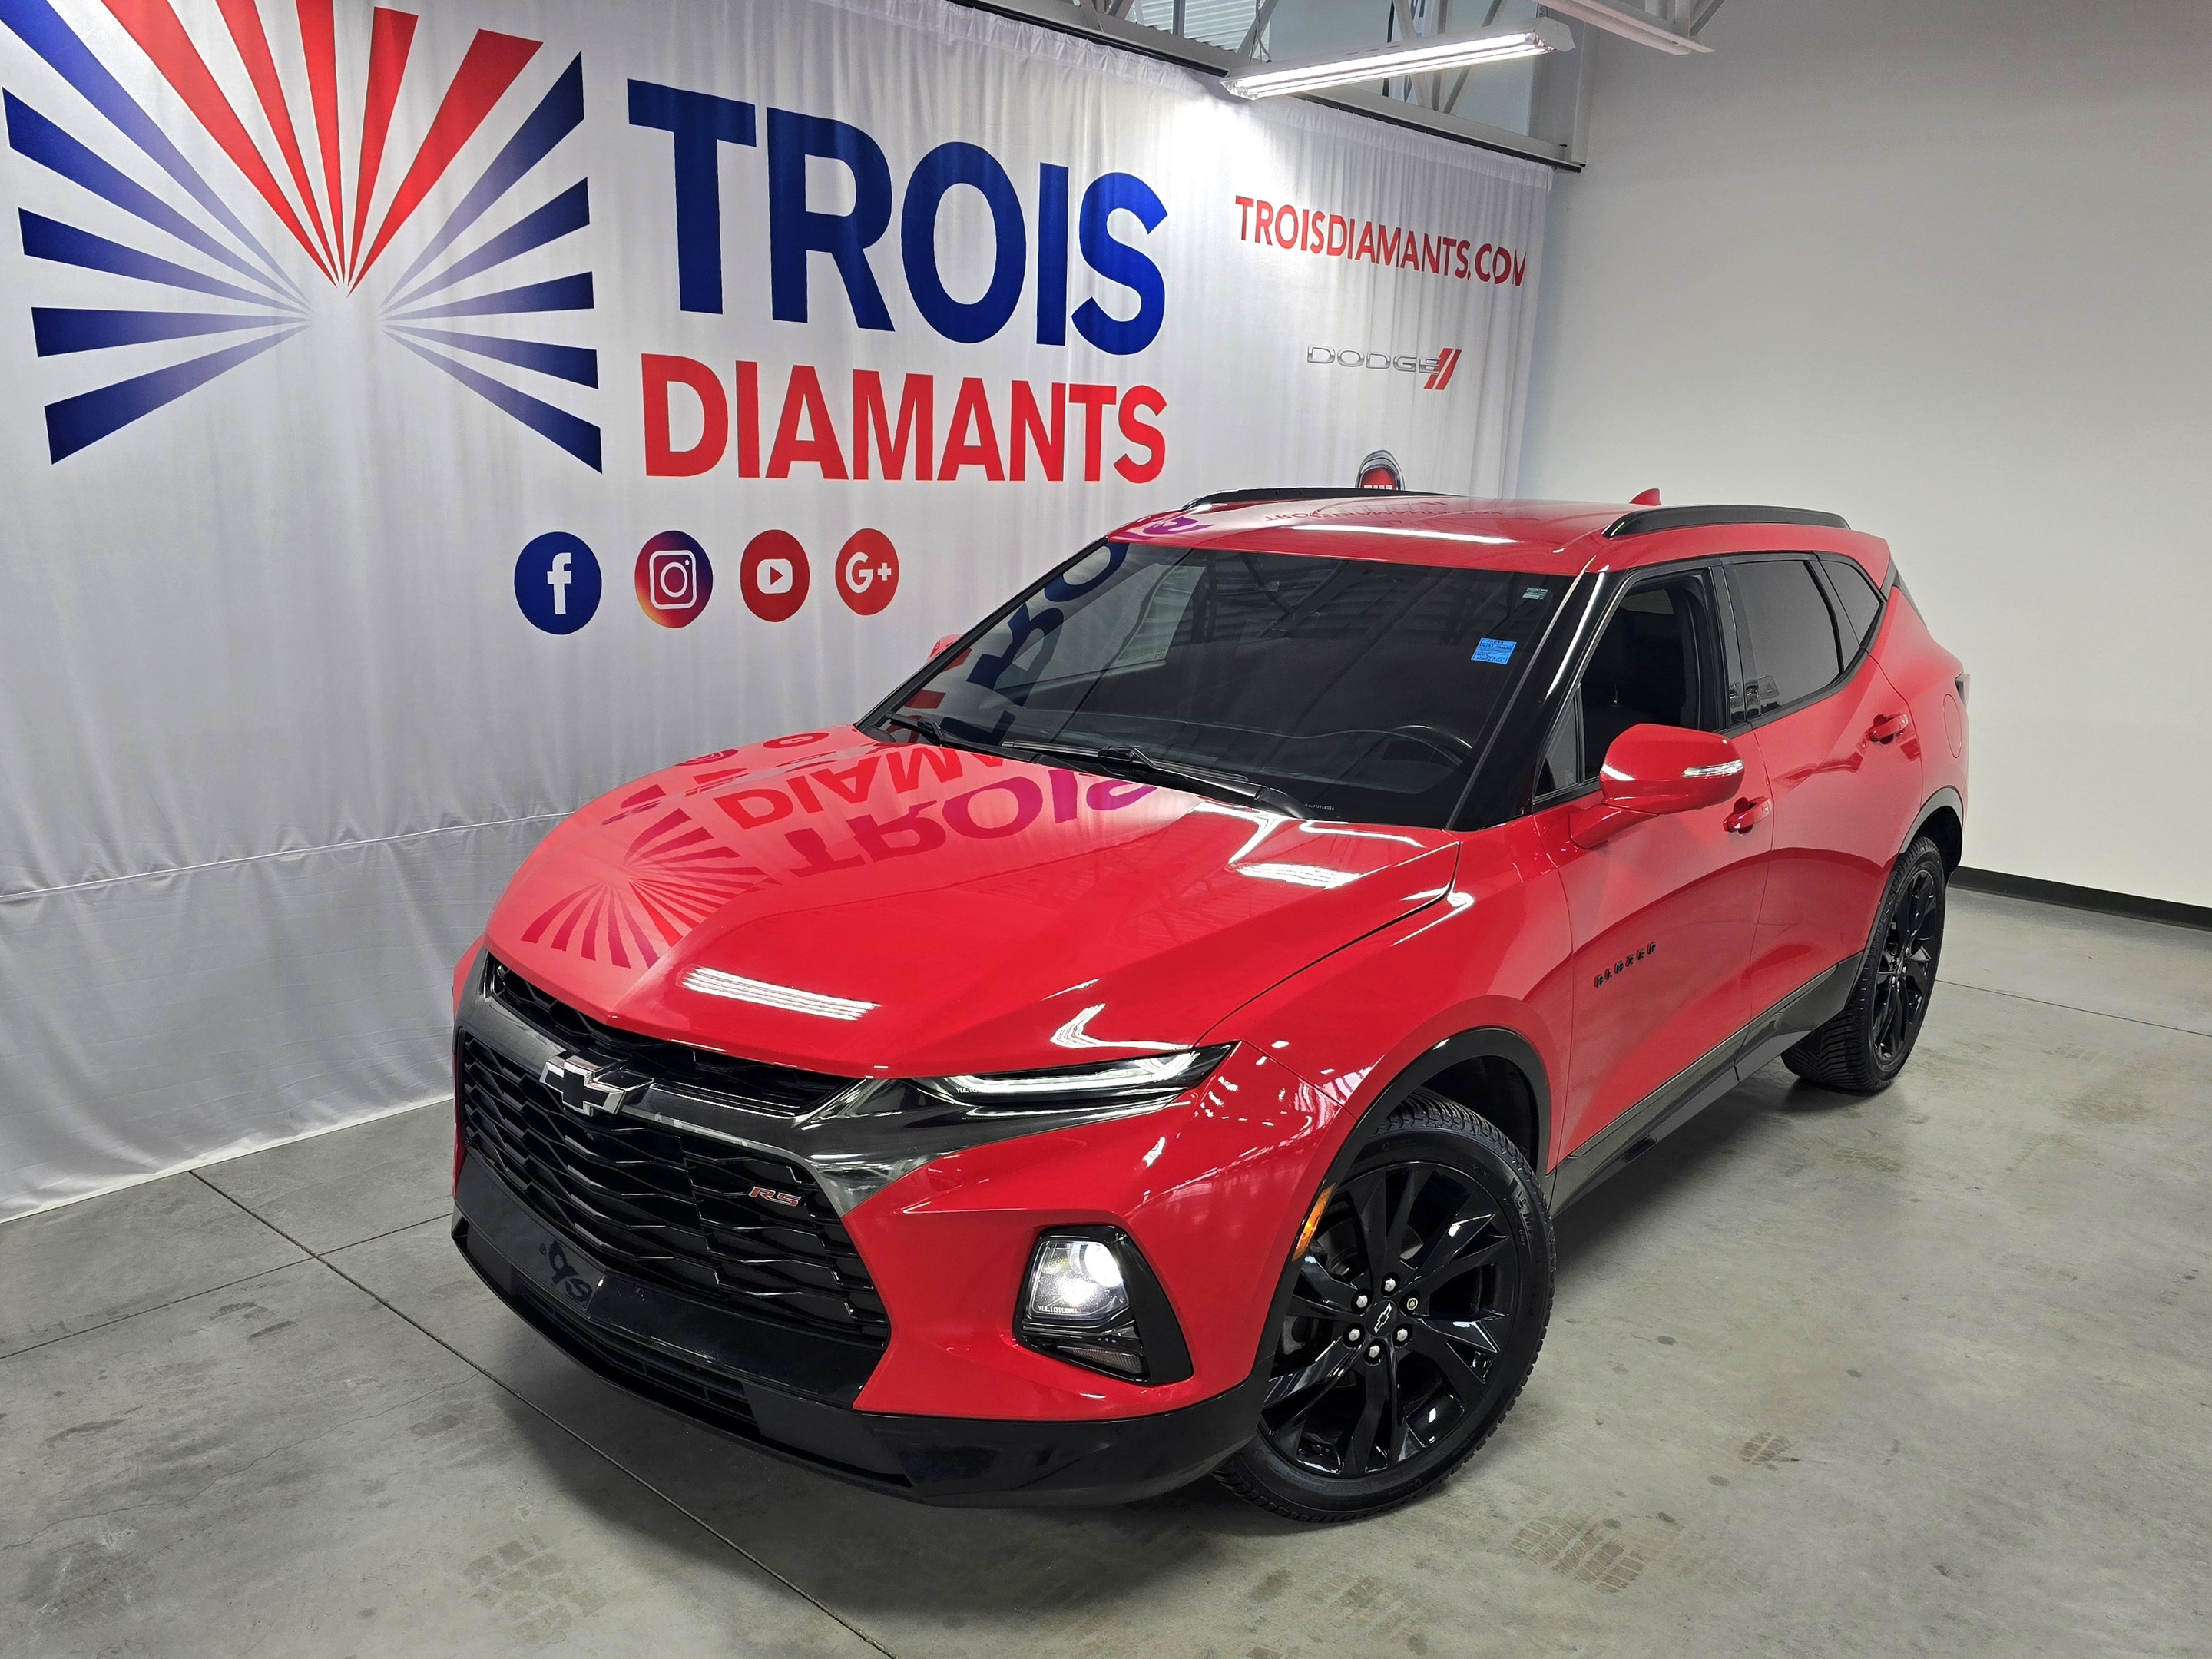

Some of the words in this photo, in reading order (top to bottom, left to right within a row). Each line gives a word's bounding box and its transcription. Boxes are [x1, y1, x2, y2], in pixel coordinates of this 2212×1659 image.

[627, 78, 1168, 355] TROIS
[1306, 345, 1441, 375] DODGE
[641, 353, 1167, 483] DIAMANTS
[748, 1186, 801, 1207] RS
